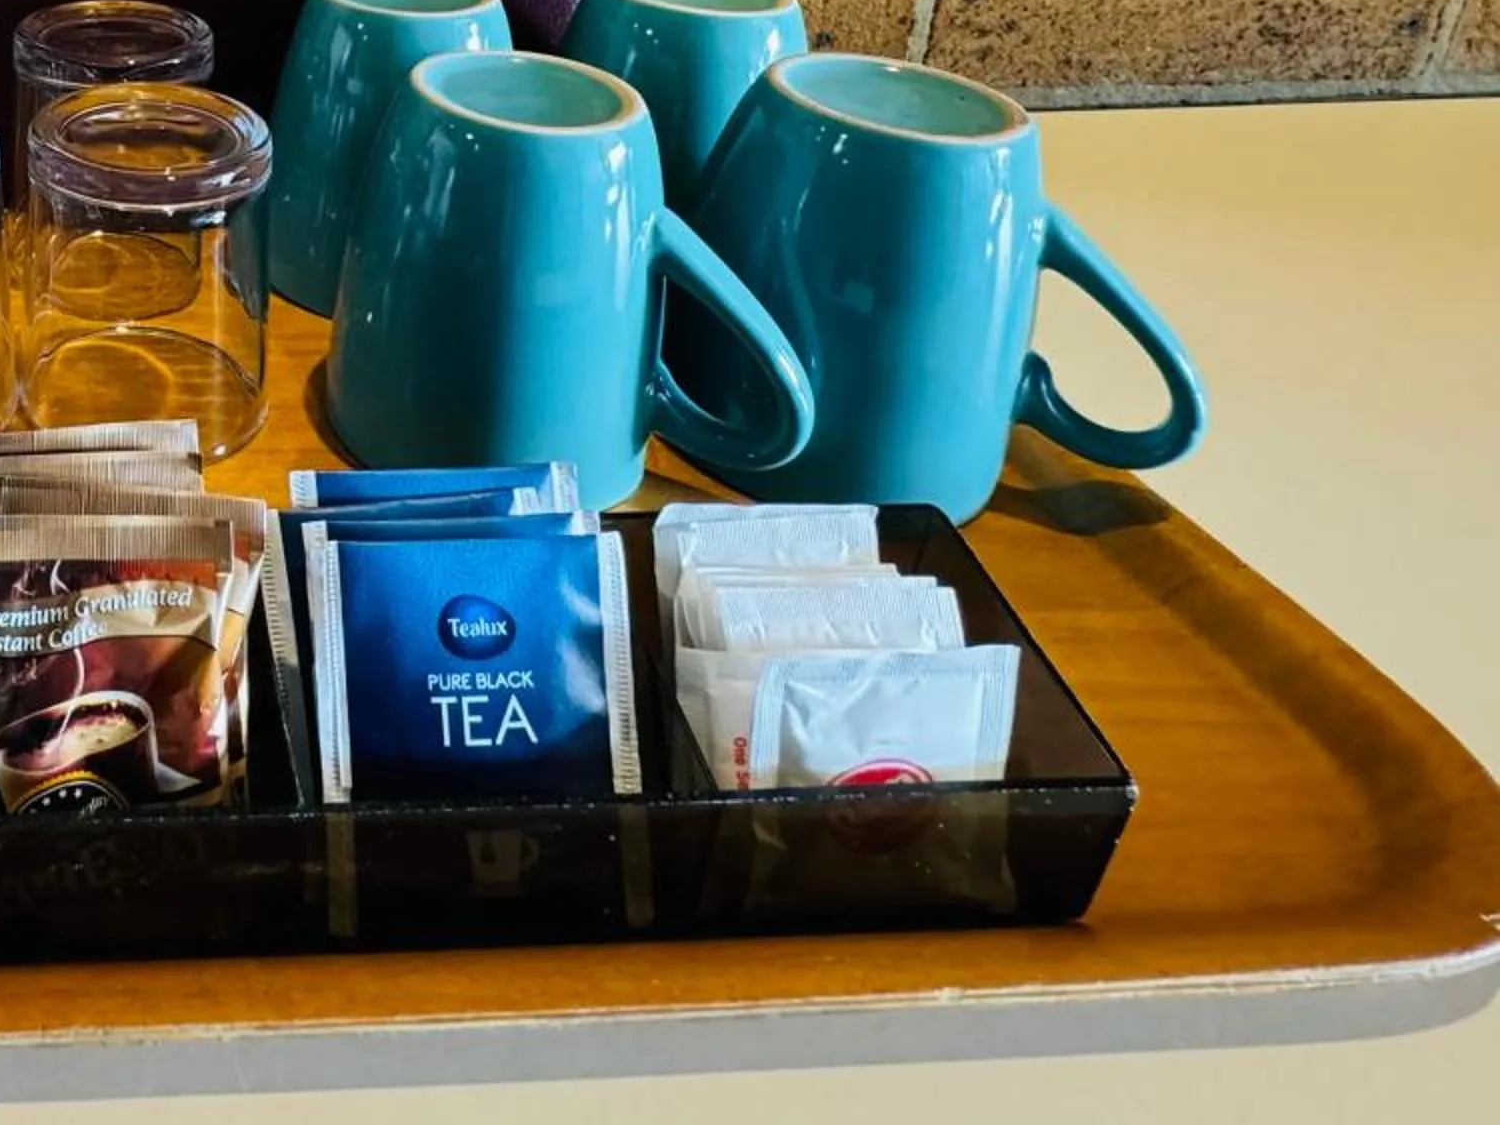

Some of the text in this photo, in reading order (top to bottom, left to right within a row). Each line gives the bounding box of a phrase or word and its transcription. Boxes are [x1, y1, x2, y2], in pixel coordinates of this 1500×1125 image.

[74, 585, 194, 618] Granulated
[49, 619, 108, 649] Coffee
[447, 616, 509, 639] Tealux
[427, 670, 535, 691] PURE BLACK
[430, 694, 539, 748] TEA
